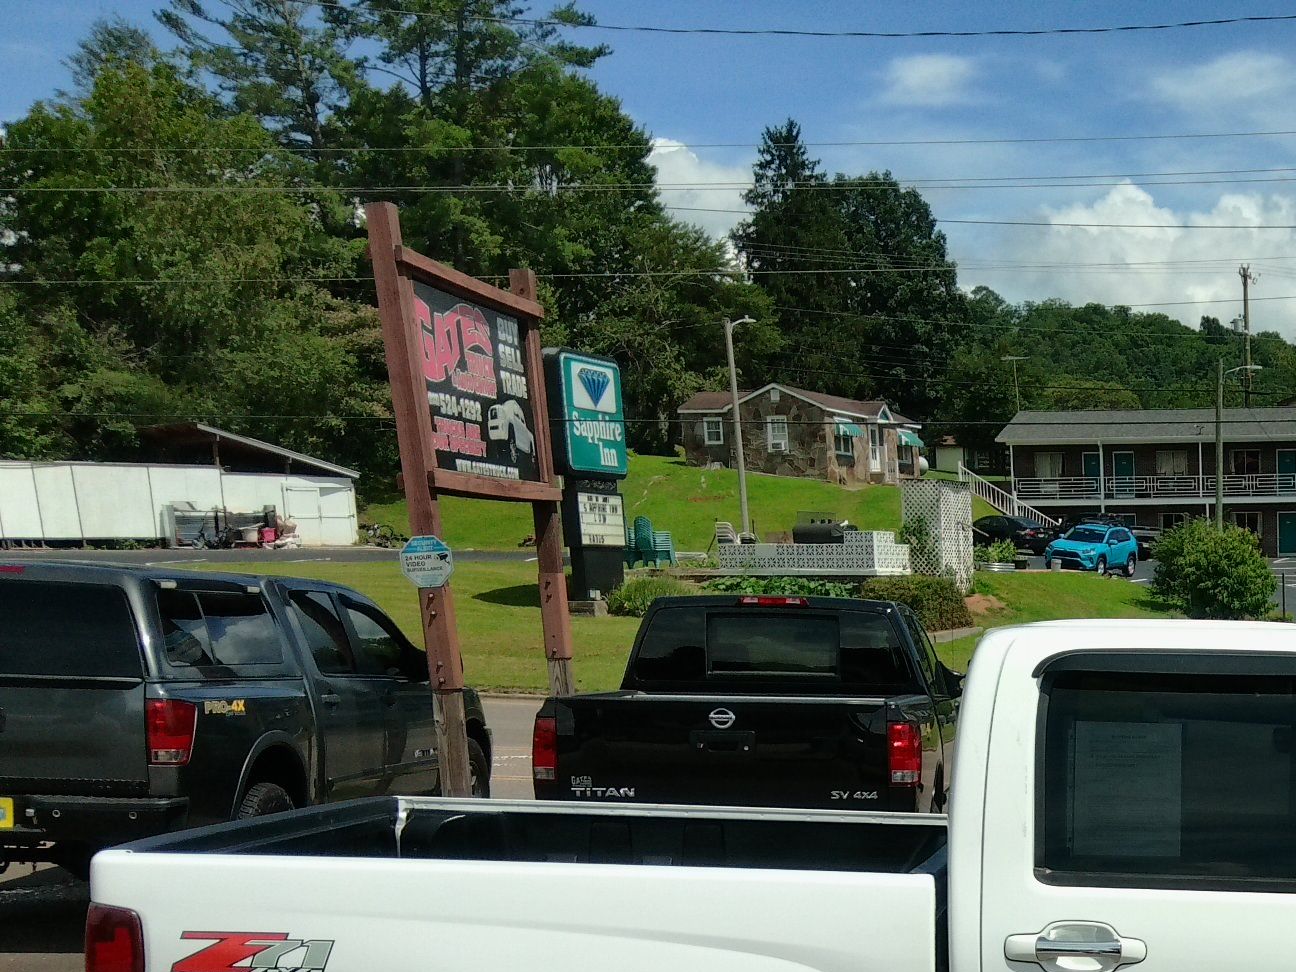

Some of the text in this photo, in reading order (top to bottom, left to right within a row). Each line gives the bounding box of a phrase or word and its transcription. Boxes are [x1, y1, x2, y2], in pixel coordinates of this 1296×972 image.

[412, 294, 493, 382] GATES
[497, 317, 518, 345] BUY
[499, 343, 524, 373] SELL
[500, 370, 528, 399] TRADE
[573, 411, 622, 444] Sapphire
[599, 441, 619, 467] Inn
[204, 699, 246, 715] PRO-4X
[570, 787, 635, 798] TITAN
[830, 790, 850, 800] SV
